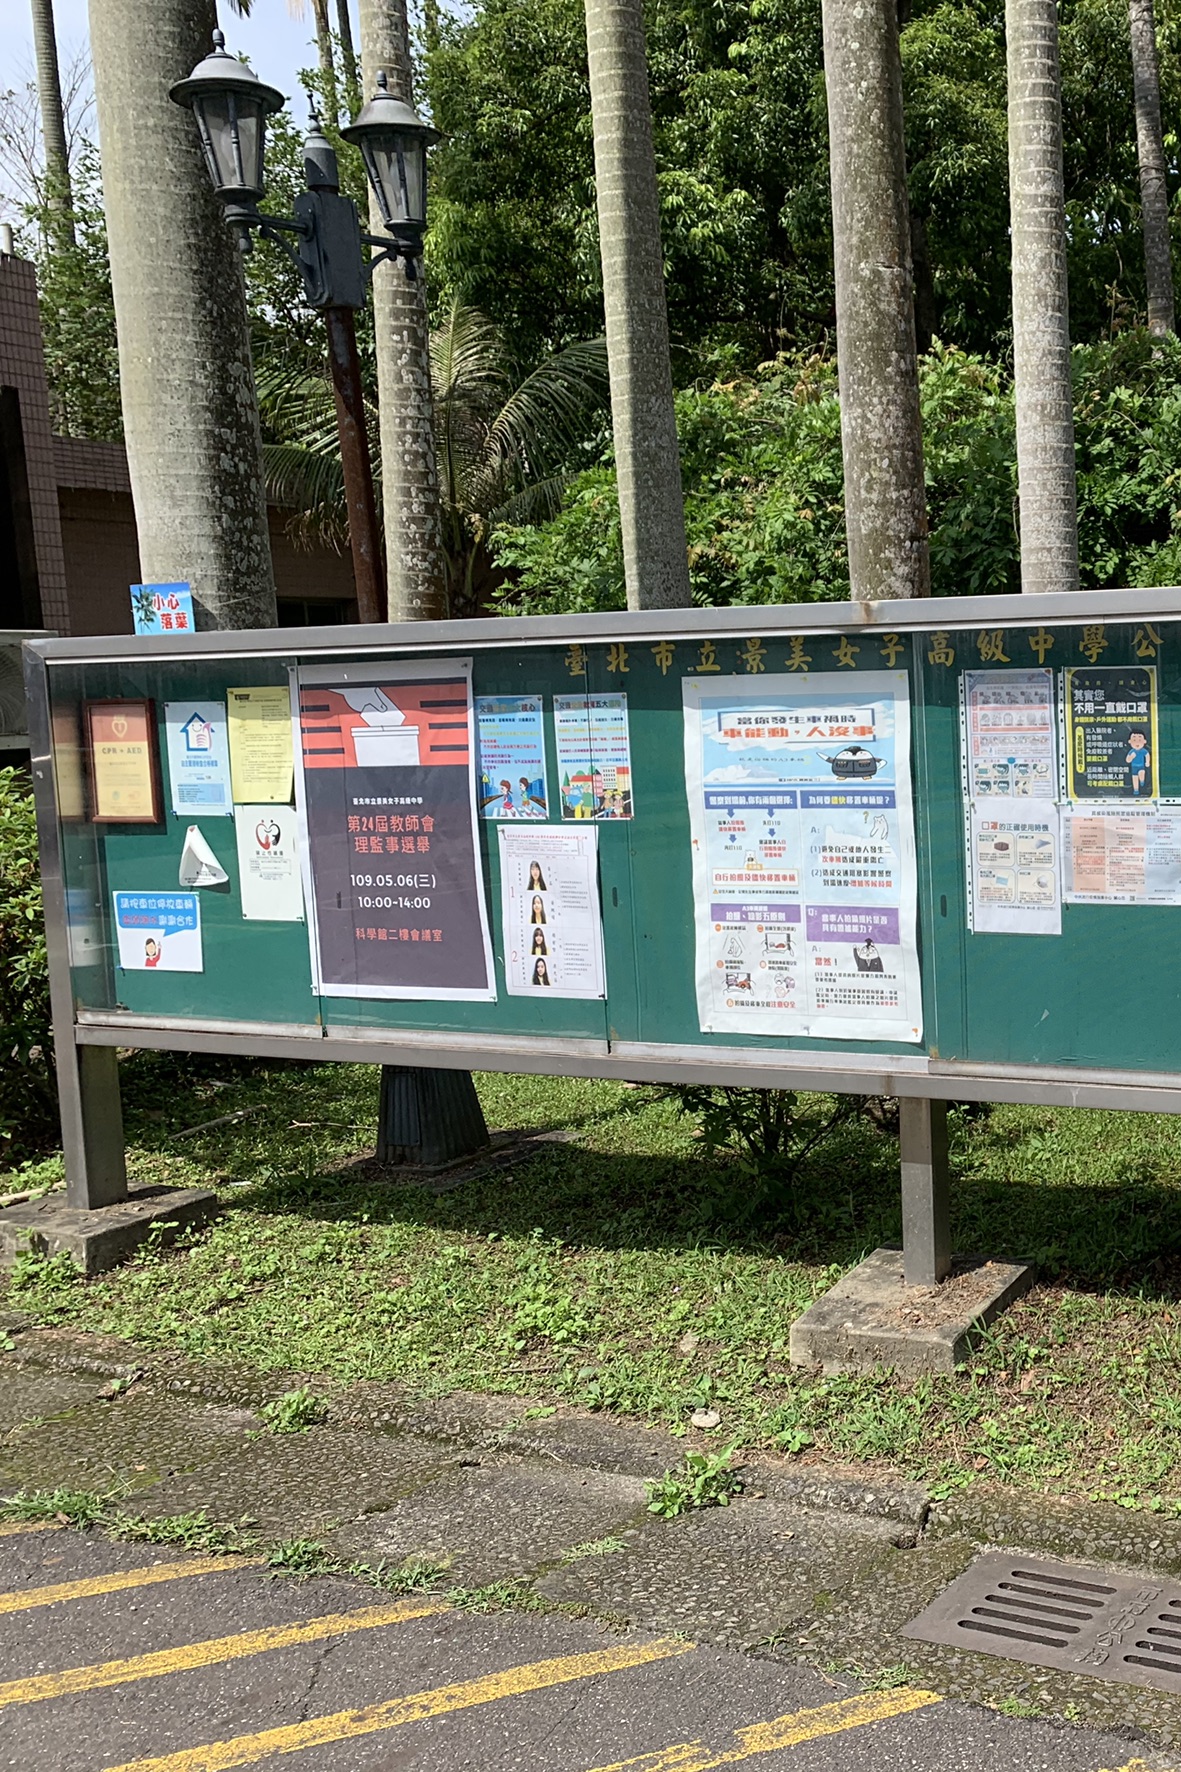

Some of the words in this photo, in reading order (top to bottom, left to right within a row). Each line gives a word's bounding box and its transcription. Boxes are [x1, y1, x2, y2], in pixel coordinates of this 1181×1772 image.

[153, 593, 180, 611] 小心
[160, 612, 189, 630] 落葉
[1073, 689, 1105, 701] 其實您
[1074, 701, 1148, 714] 不用一直戴口罩
[347, 814, 435, 833] 第24屆教師會
[981, 821, 1050, 832] 口罩的正確使用時機
[354, 835, 431, 854] 理監事選舉
[350, 873, 437, 889] 109.05.06(三)
[357, 896, 431, 909] 10:00~14:00
[355, 927, 443, 942] 科學館二樓會議室
